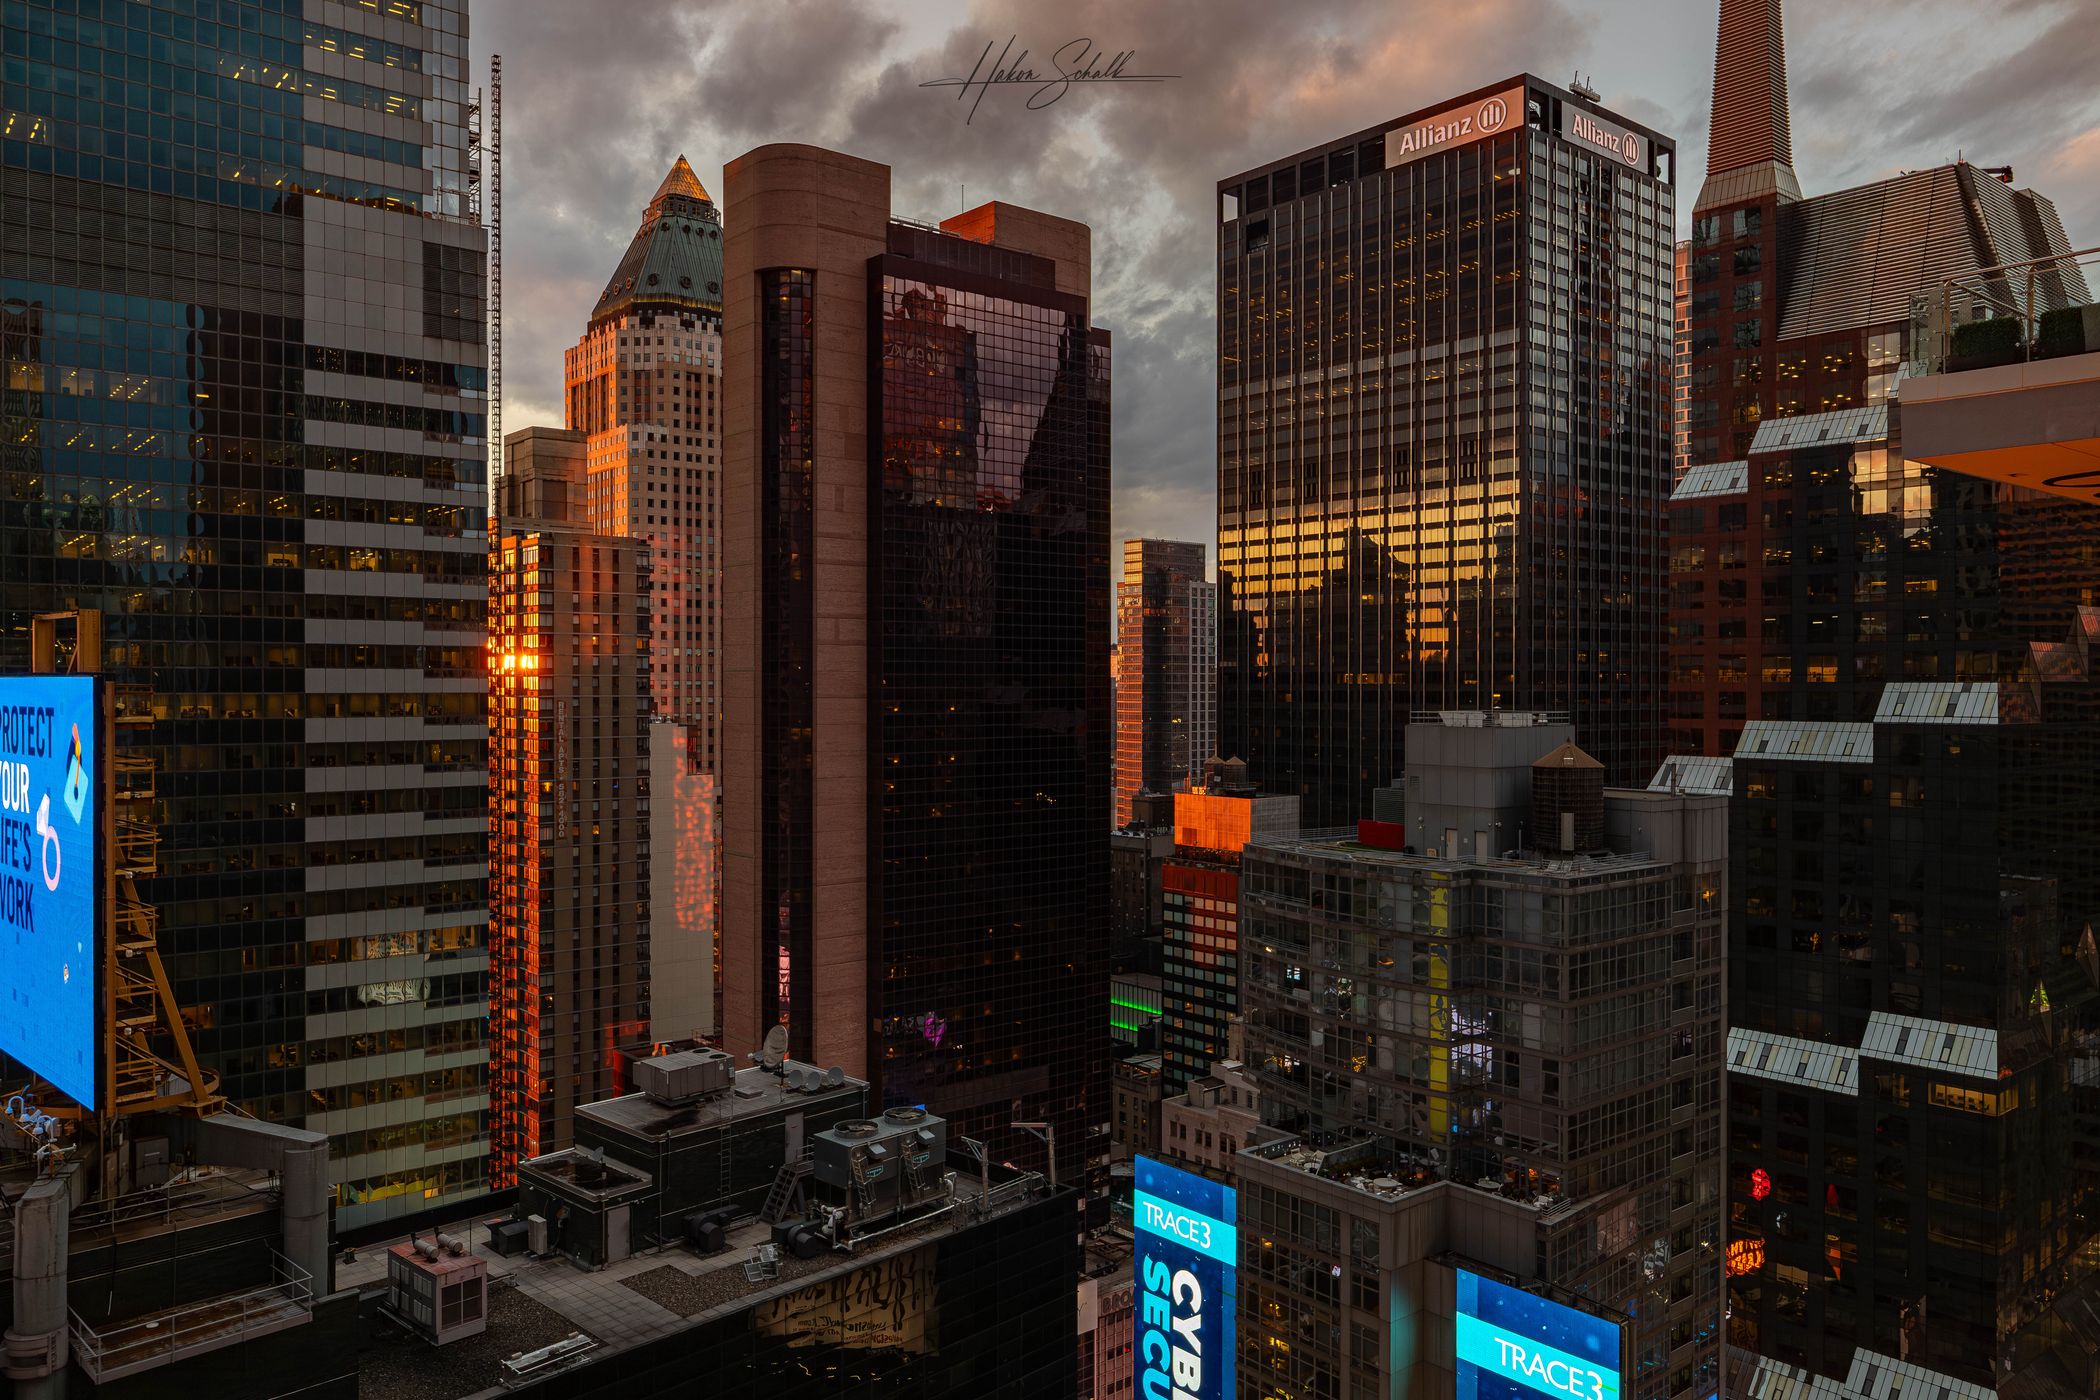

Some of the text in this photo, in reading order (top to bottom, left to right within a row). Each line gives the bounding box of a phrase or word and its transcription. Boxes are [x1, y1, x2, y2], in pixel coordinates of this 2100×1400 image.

[1400, 116, 1472, 155] Allianz
[1572, 113, 1620, 153] Allianz
[0, 704, 55, 758] ROTECT
[0, 760, 30, 813] OUR
[0, 815, 31, 872] IFE'S
[1142, 1200, 1211, 1249] TRACE3
[1102, 1289, 1134, 1314] BRO
[1493, 1337, 1603, 1400] TRACE3
